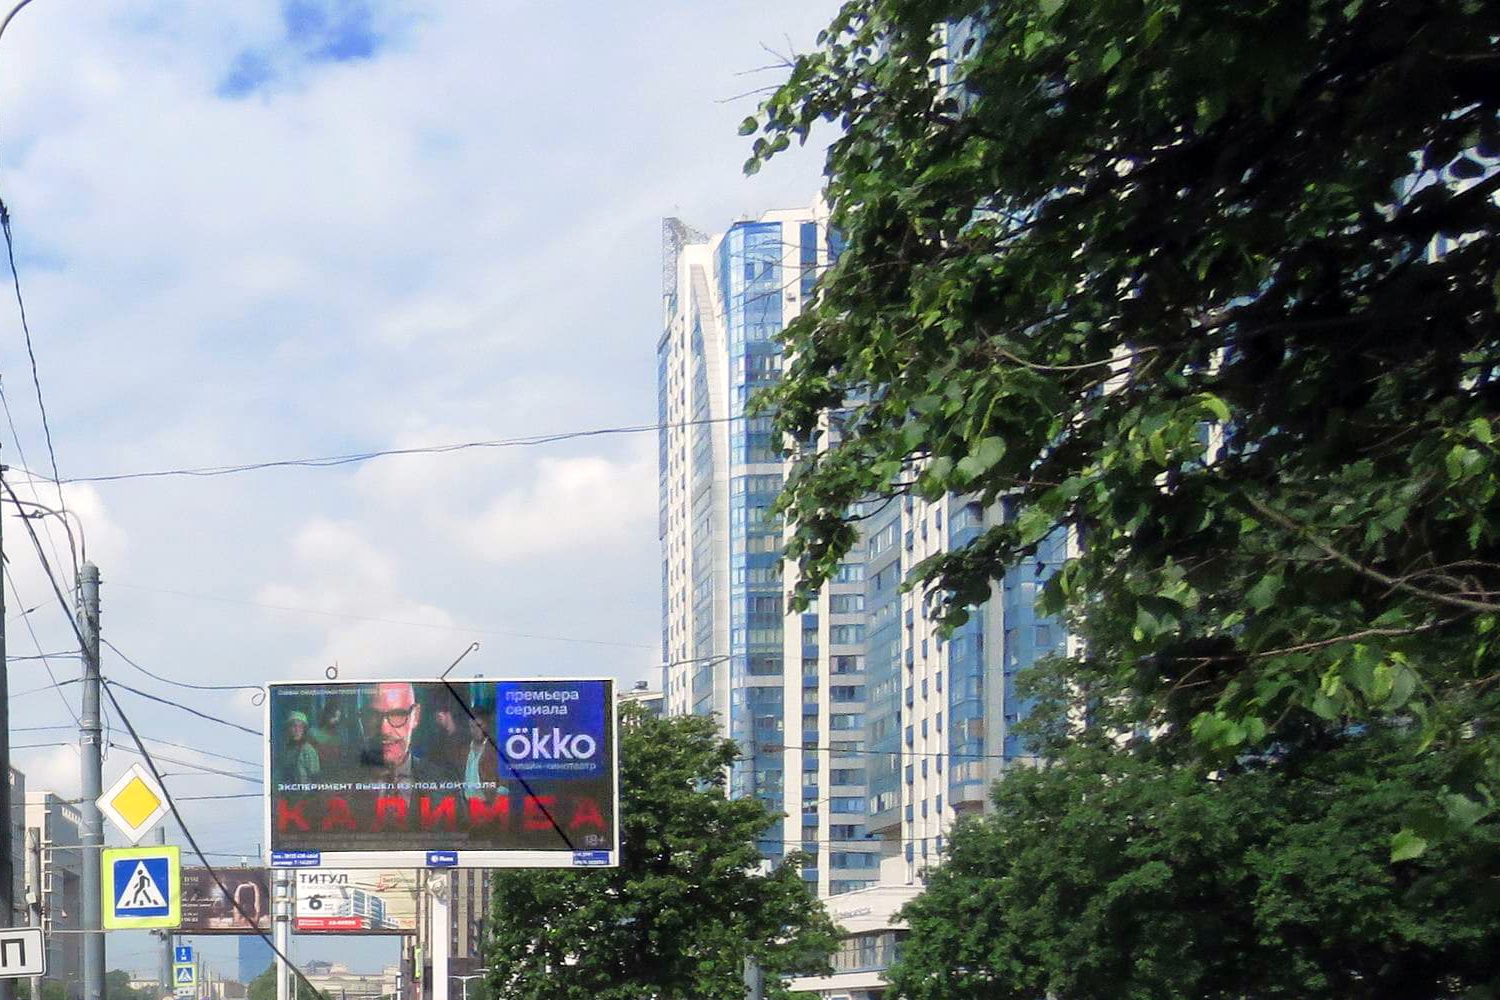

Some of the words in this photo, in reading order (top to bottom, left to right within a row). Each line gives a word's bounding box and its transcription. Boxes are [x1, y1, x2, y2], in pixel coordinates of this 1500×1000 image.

[506, 690, 579, 703] премьера
[506, 705, 568, 717] сериала
[277, 783, 352, 791] ЭКСПЕРИМЕНТ
[276, 794, 606, 832] КАЛИМБА
[300, 873, 349, 884] ТИТУЛ
